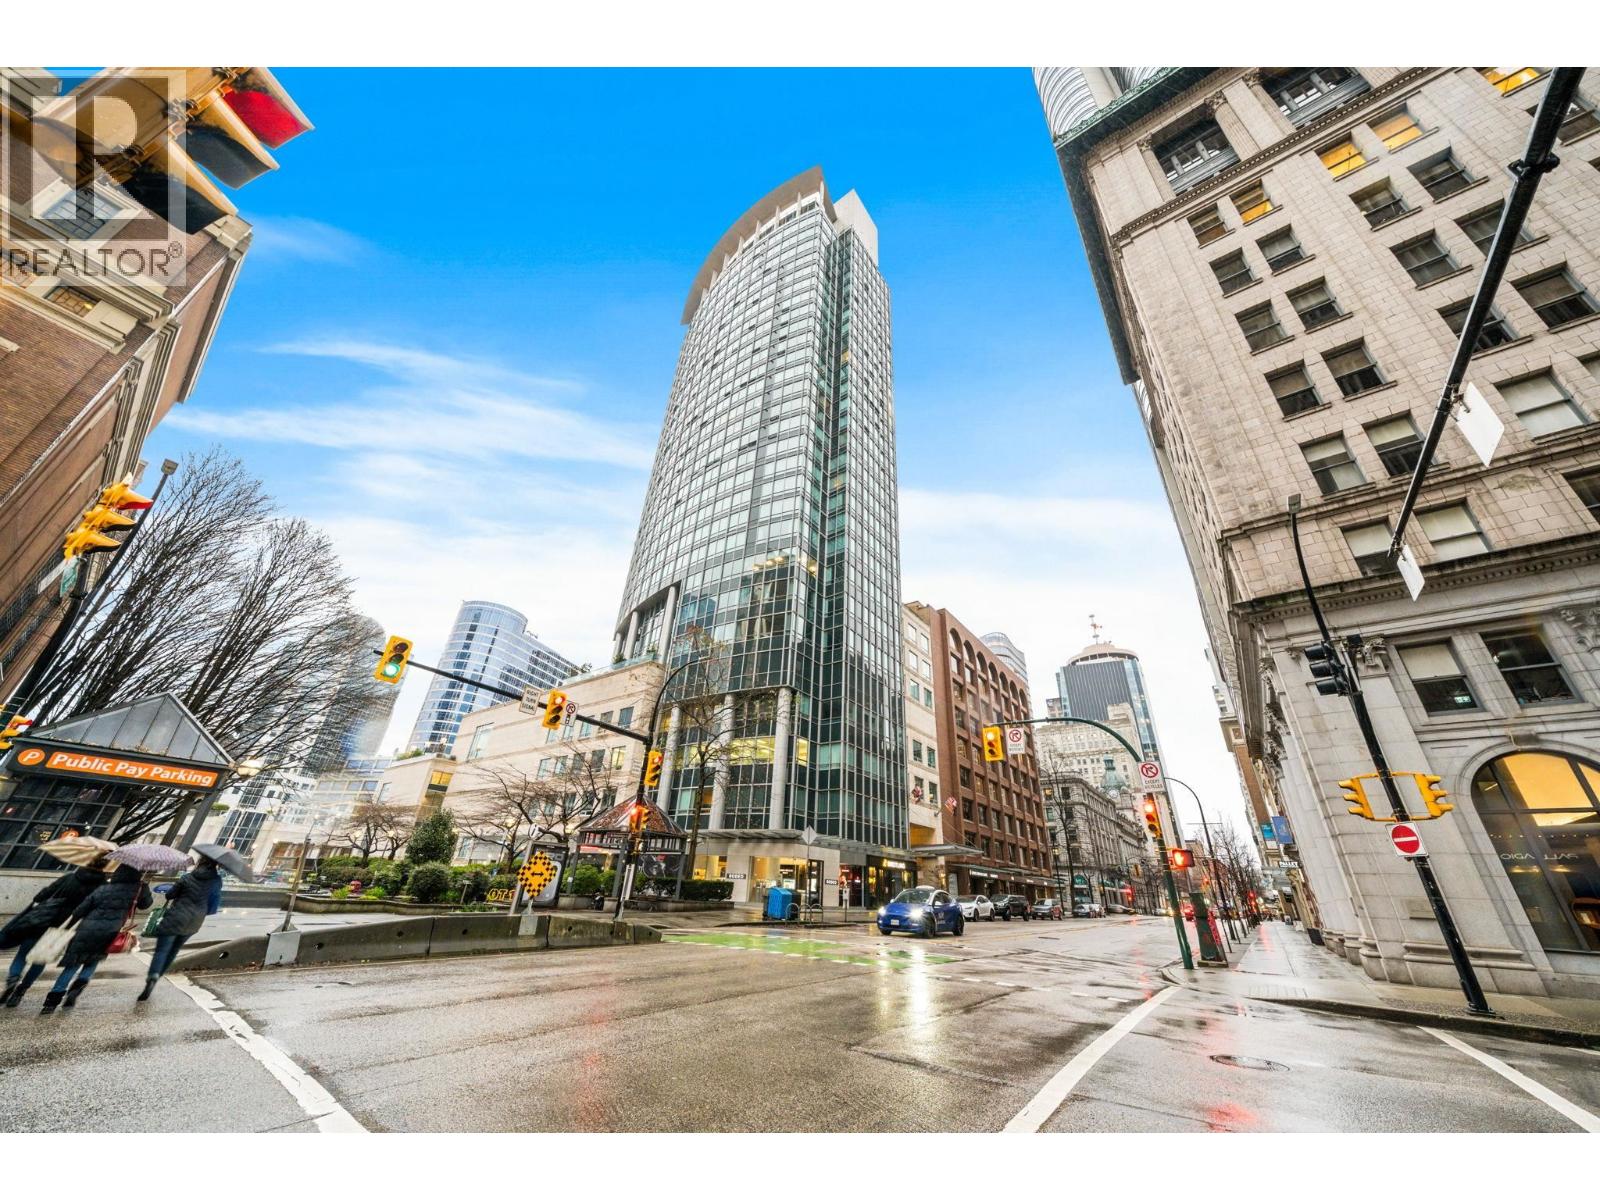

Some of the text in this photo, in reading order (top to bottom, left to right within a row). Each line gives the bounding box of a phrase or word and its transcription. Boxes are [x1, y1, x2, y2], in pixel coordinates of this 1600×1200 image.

[52, 753, 213, 785] Public Pay Parking
